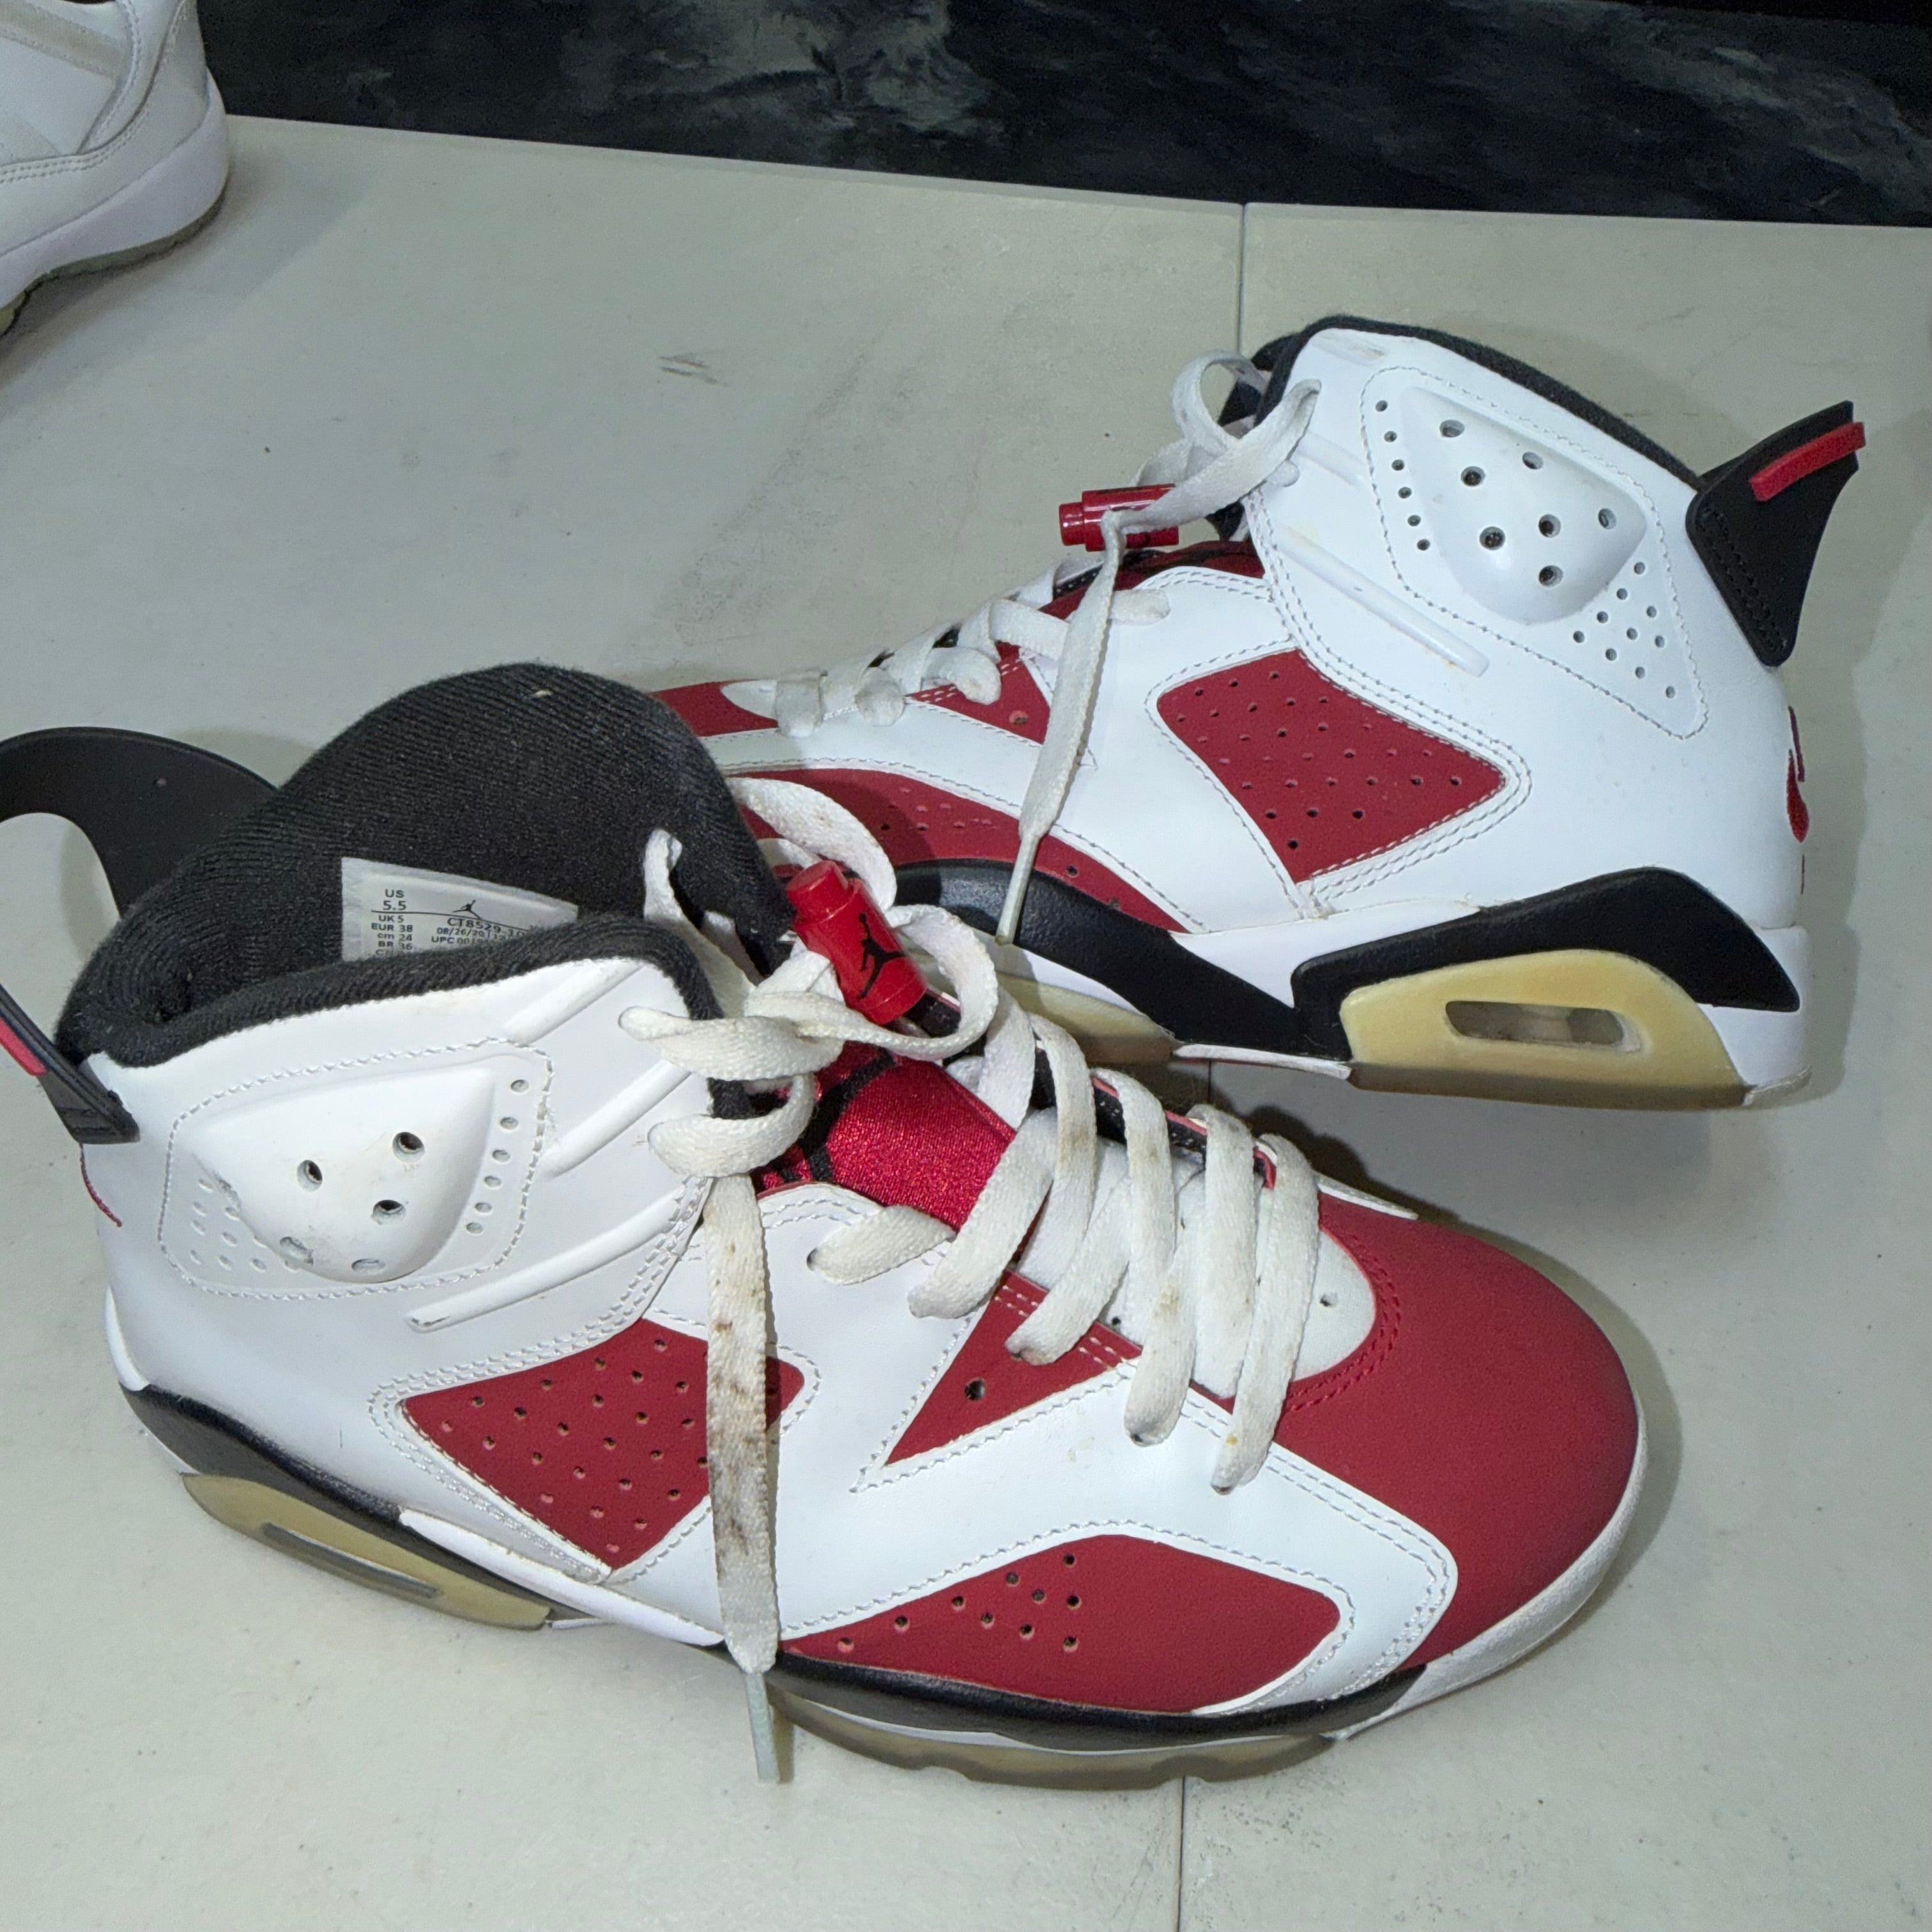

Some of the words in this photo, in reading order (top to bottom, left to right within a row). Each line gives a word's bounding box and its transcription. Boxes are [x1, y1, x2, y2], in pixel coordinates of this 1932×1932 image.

[385, 889, 404, 898] US
[383, 900, 407, 910] 5.5
[397, 915, 404, 923] 5
[371, 923, 394, 931] EUR
[399, 924, 413, 933] 38
[447, 917, 526, 937] CT8529-10
[399, 933, 413, 942] 24
[431, 936, 455, 944] UPC
